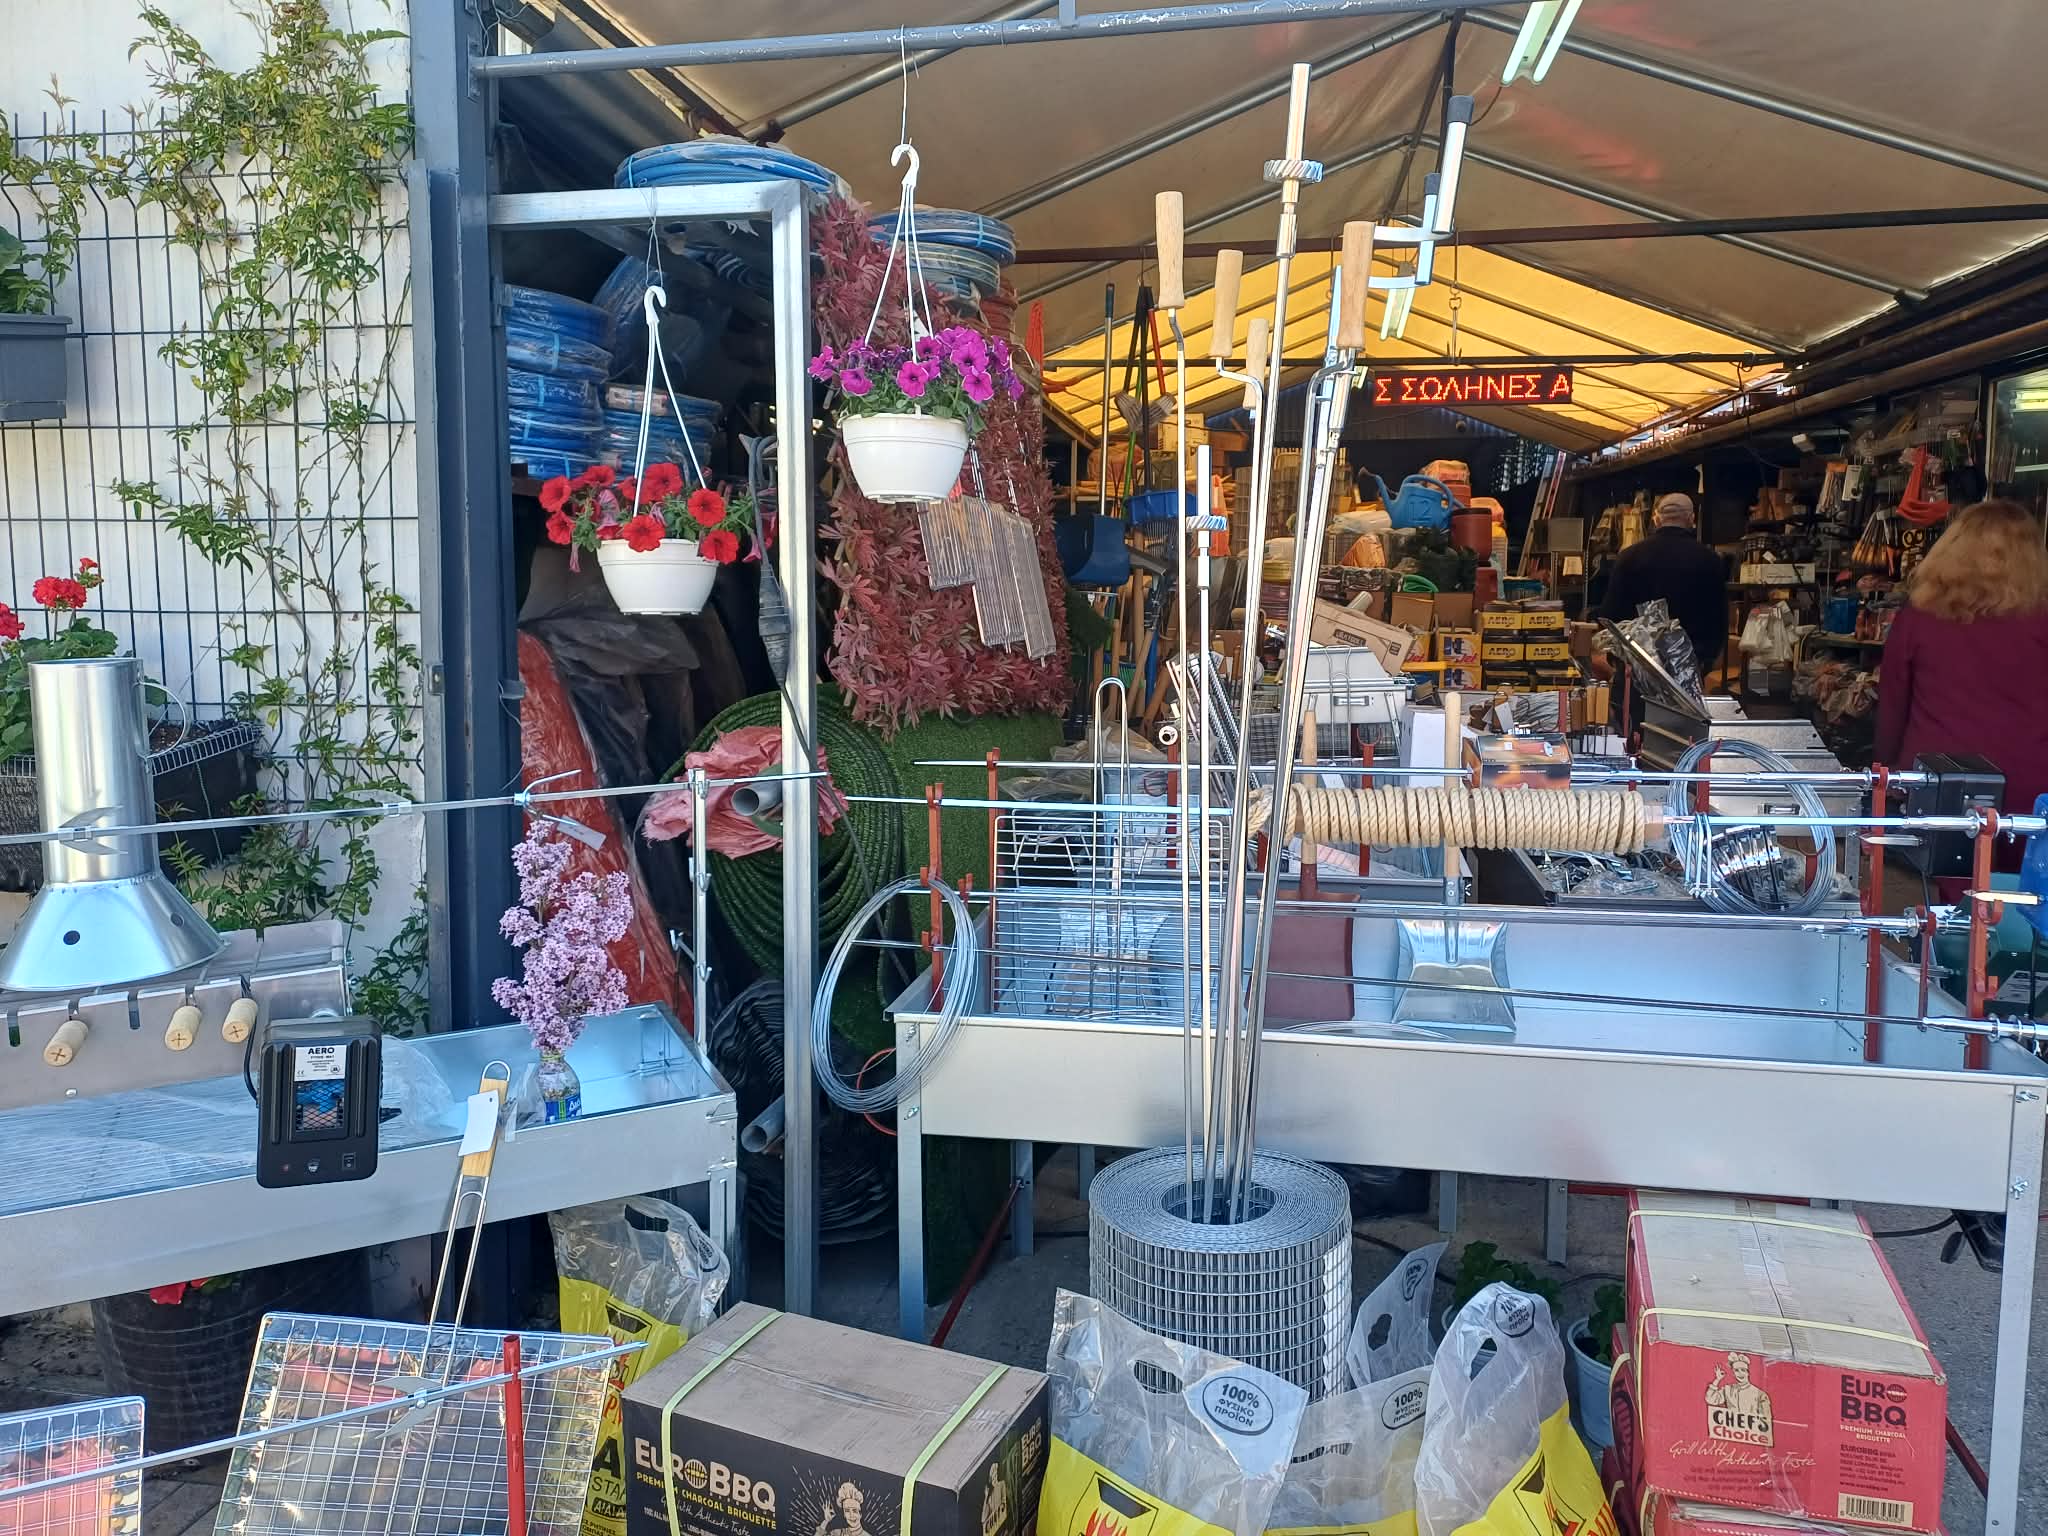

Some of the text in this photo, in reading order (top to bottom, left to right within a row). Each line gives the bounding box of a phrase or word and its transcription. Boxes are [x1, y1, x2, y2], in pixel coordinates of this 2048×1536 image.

[1401, 374, 1542, 401] ΣΩΛΗΝΕΣ
[308, 1047, 335, 1055] AERO
[1222, 1383, 1260, 1409] 100%
[1394, 1387, 1423, 1408] 100%
[1218, 1398, 1255, 1417] ΦΥΣΙΚΟ
[1841, 1395, 1907, 1427] BBQ
[1713, 1410, 1769, 1433] CHEF'S
[1840, 1425, 1873, 1435] PREMIUM
[1713, 1425, 1769, 1444] Choice
[636, 1471, 679, 1494] PREMIM
[681, 1489, 725, 1512] CHARCOAL
[727, 1506, 777, 1530] BRIQUETTE
